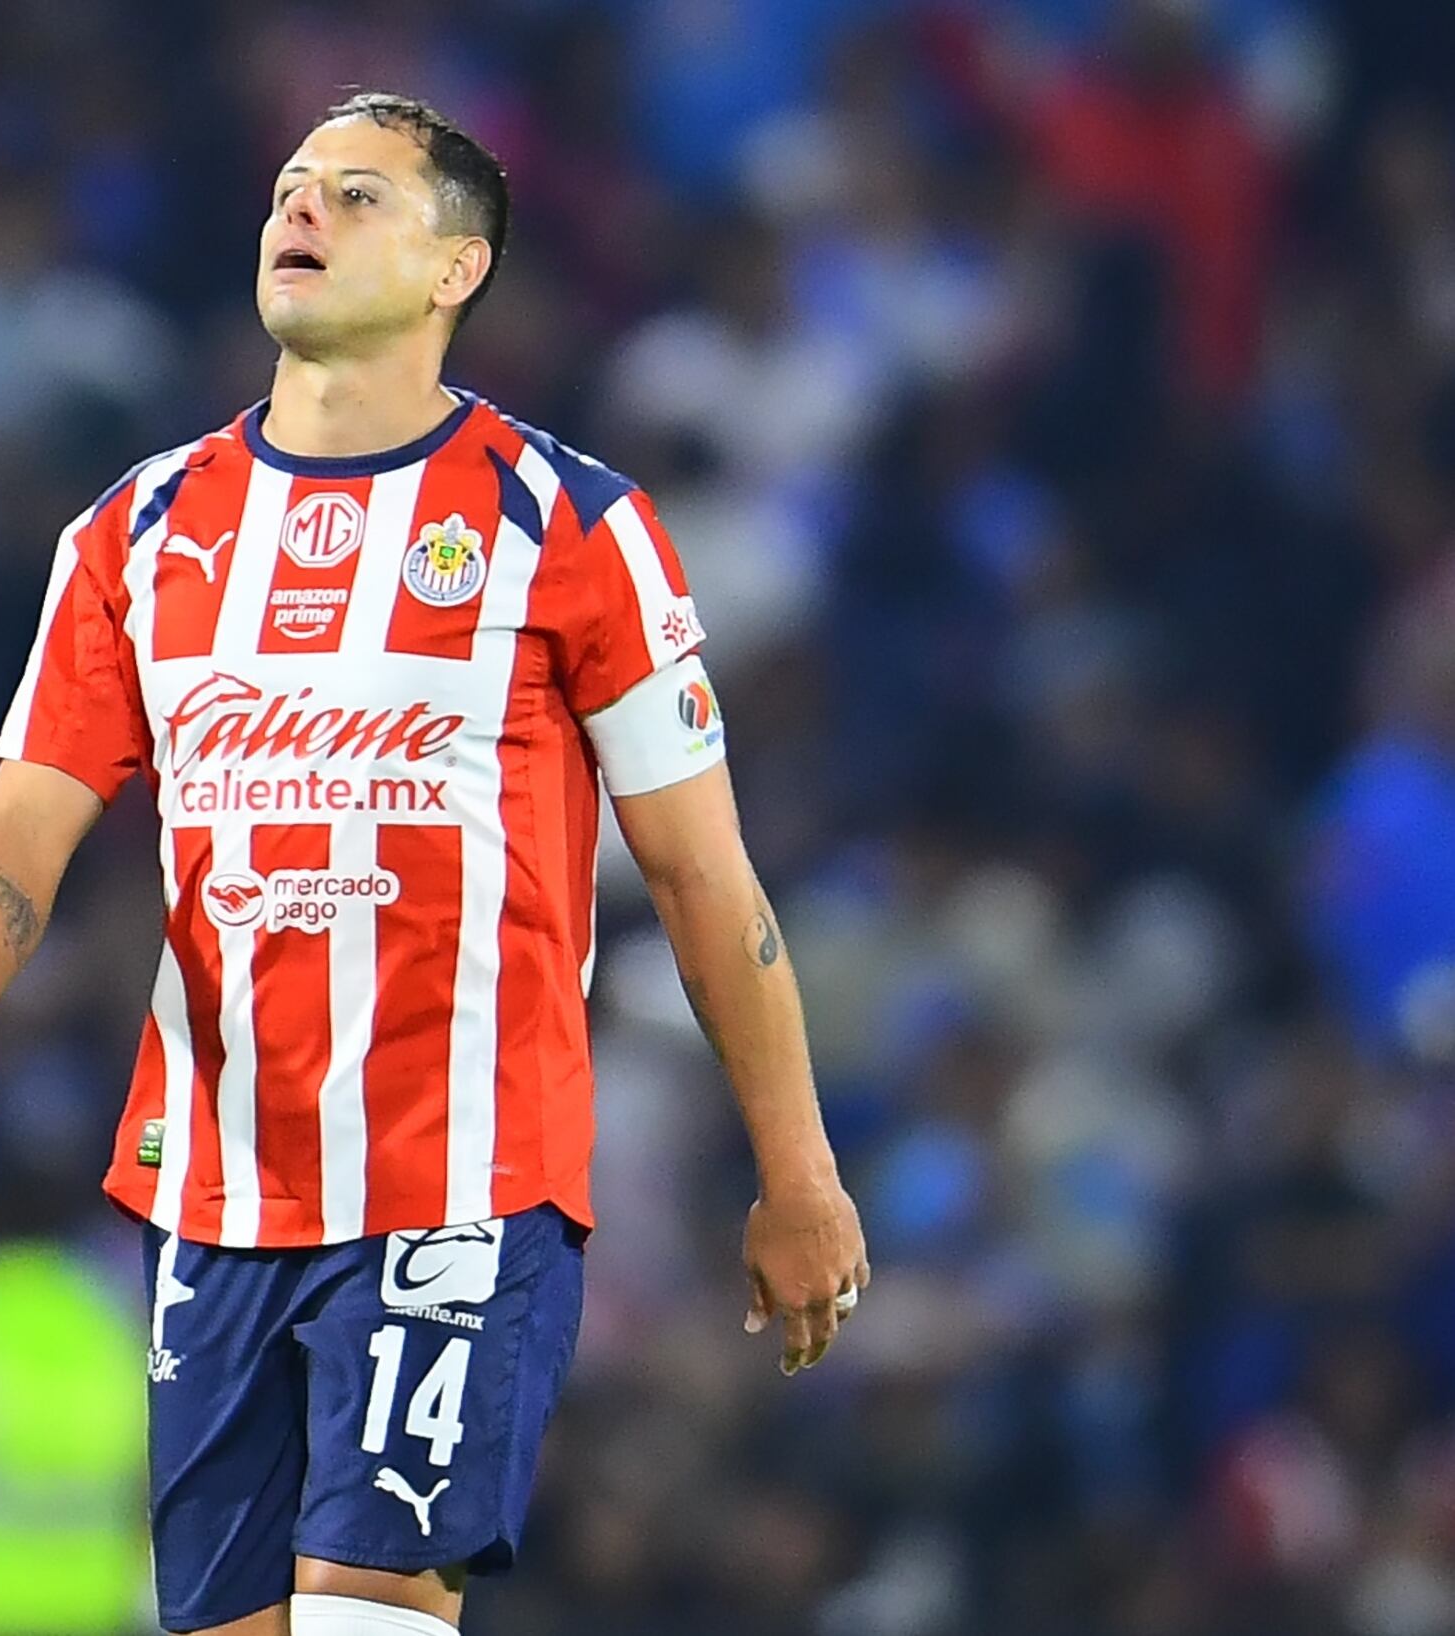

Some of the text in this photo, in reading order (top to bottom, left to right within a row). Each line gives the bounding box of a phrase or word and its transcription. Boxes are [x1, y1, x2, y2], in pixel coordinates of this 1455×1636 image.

[293, 503, 353, 556] MG
[271, 589, 348, 605] amazon
[274, 606, 336, 628] prime
[162, 670, 465, 779] Caliente
[181, 769, 448, 813] caliente.mx
[274, 874, 392, 898] mercado
[274, 901, 337, 925] pago
[361, 1324, 472, 1467] 14
